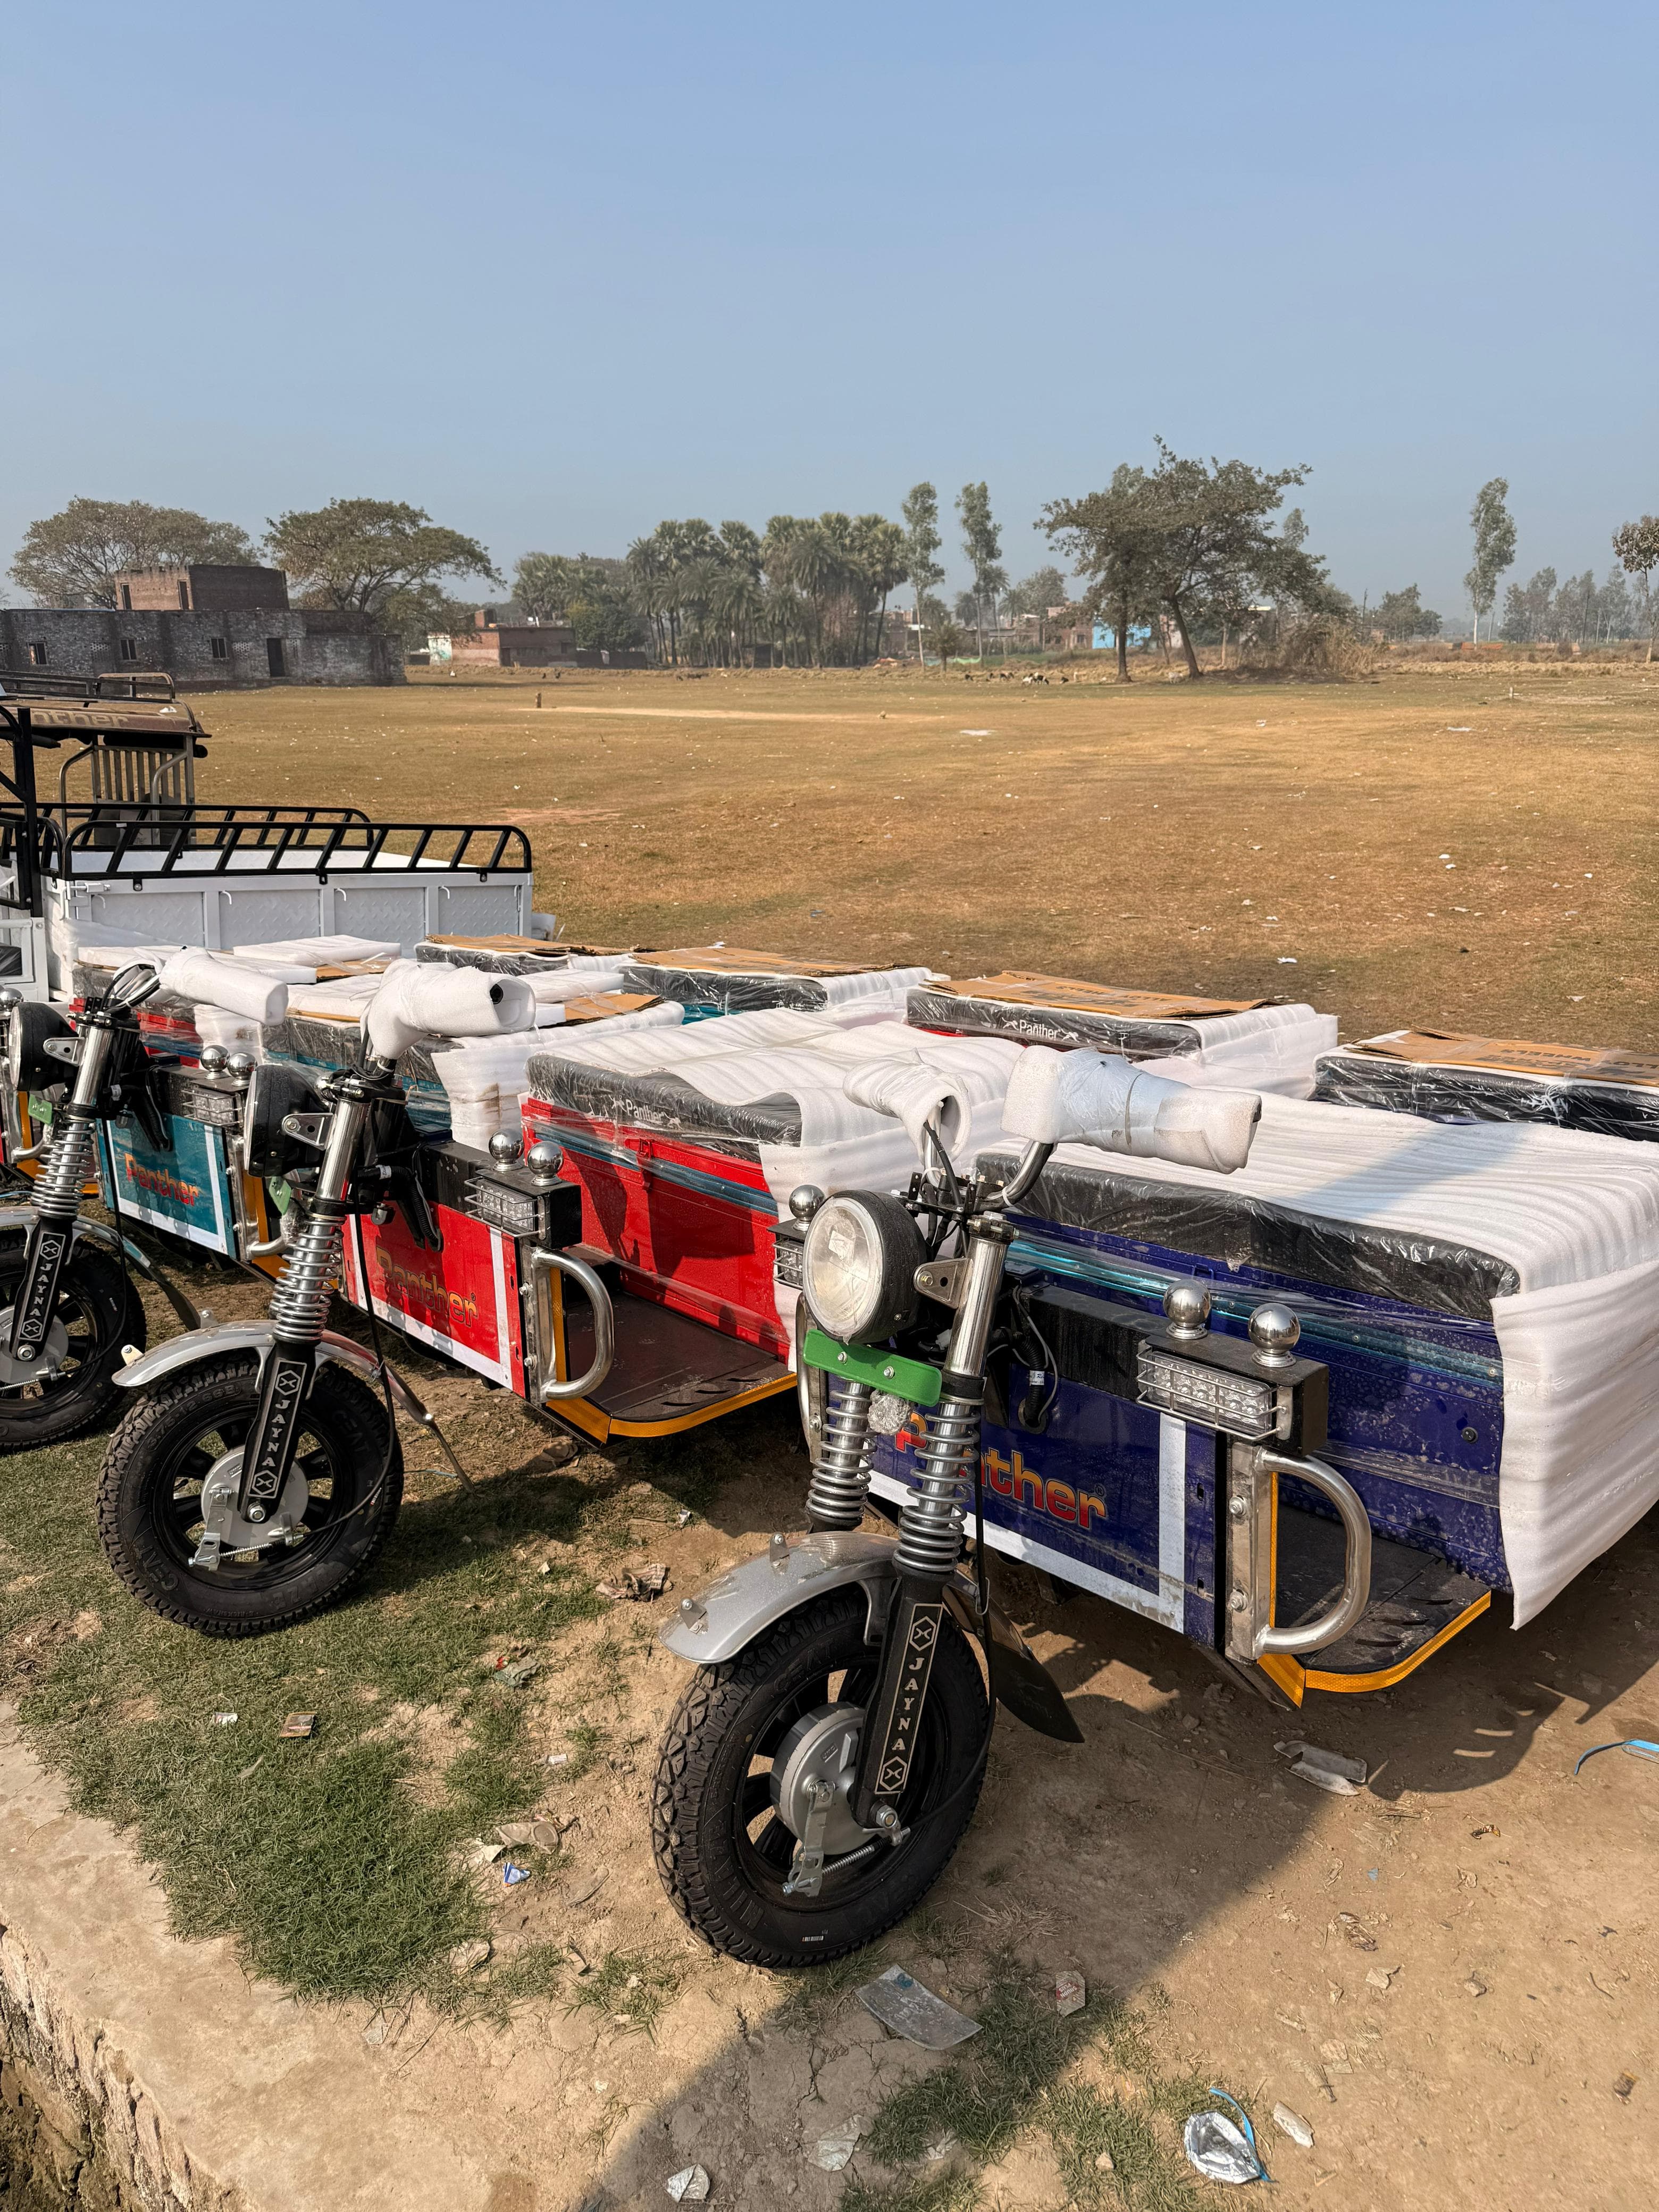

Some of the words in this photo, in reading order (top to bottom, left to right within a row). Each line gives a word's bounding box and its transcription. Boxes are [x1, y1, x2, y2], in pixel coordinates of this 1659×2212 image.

[31, 709, 129, 728] nther
[1019, 1019, 1058, 1041] Panther
[1499, 1049, 1591, 1062] WHEELS
[1601, 1060, 1659, 1069] LLOY
[625, 1098, 665, 1122] Panther
[124, 1152, 199, 1206] Panther
[29, 1262, 54, 1317] JAYNA
[375, 1245, 478, 1327] Panther
[261, 1399, 291, 1467] JAYNA
[894, 1411, 1107, 1529] Pther
[135, 1544, 180, 1591] CEAT
[772, 1636, 834, 1692] CEAT
[891, 1657, 925, 1750] JAYNA
[1058, 1982, 1072, 1992] PLUS
